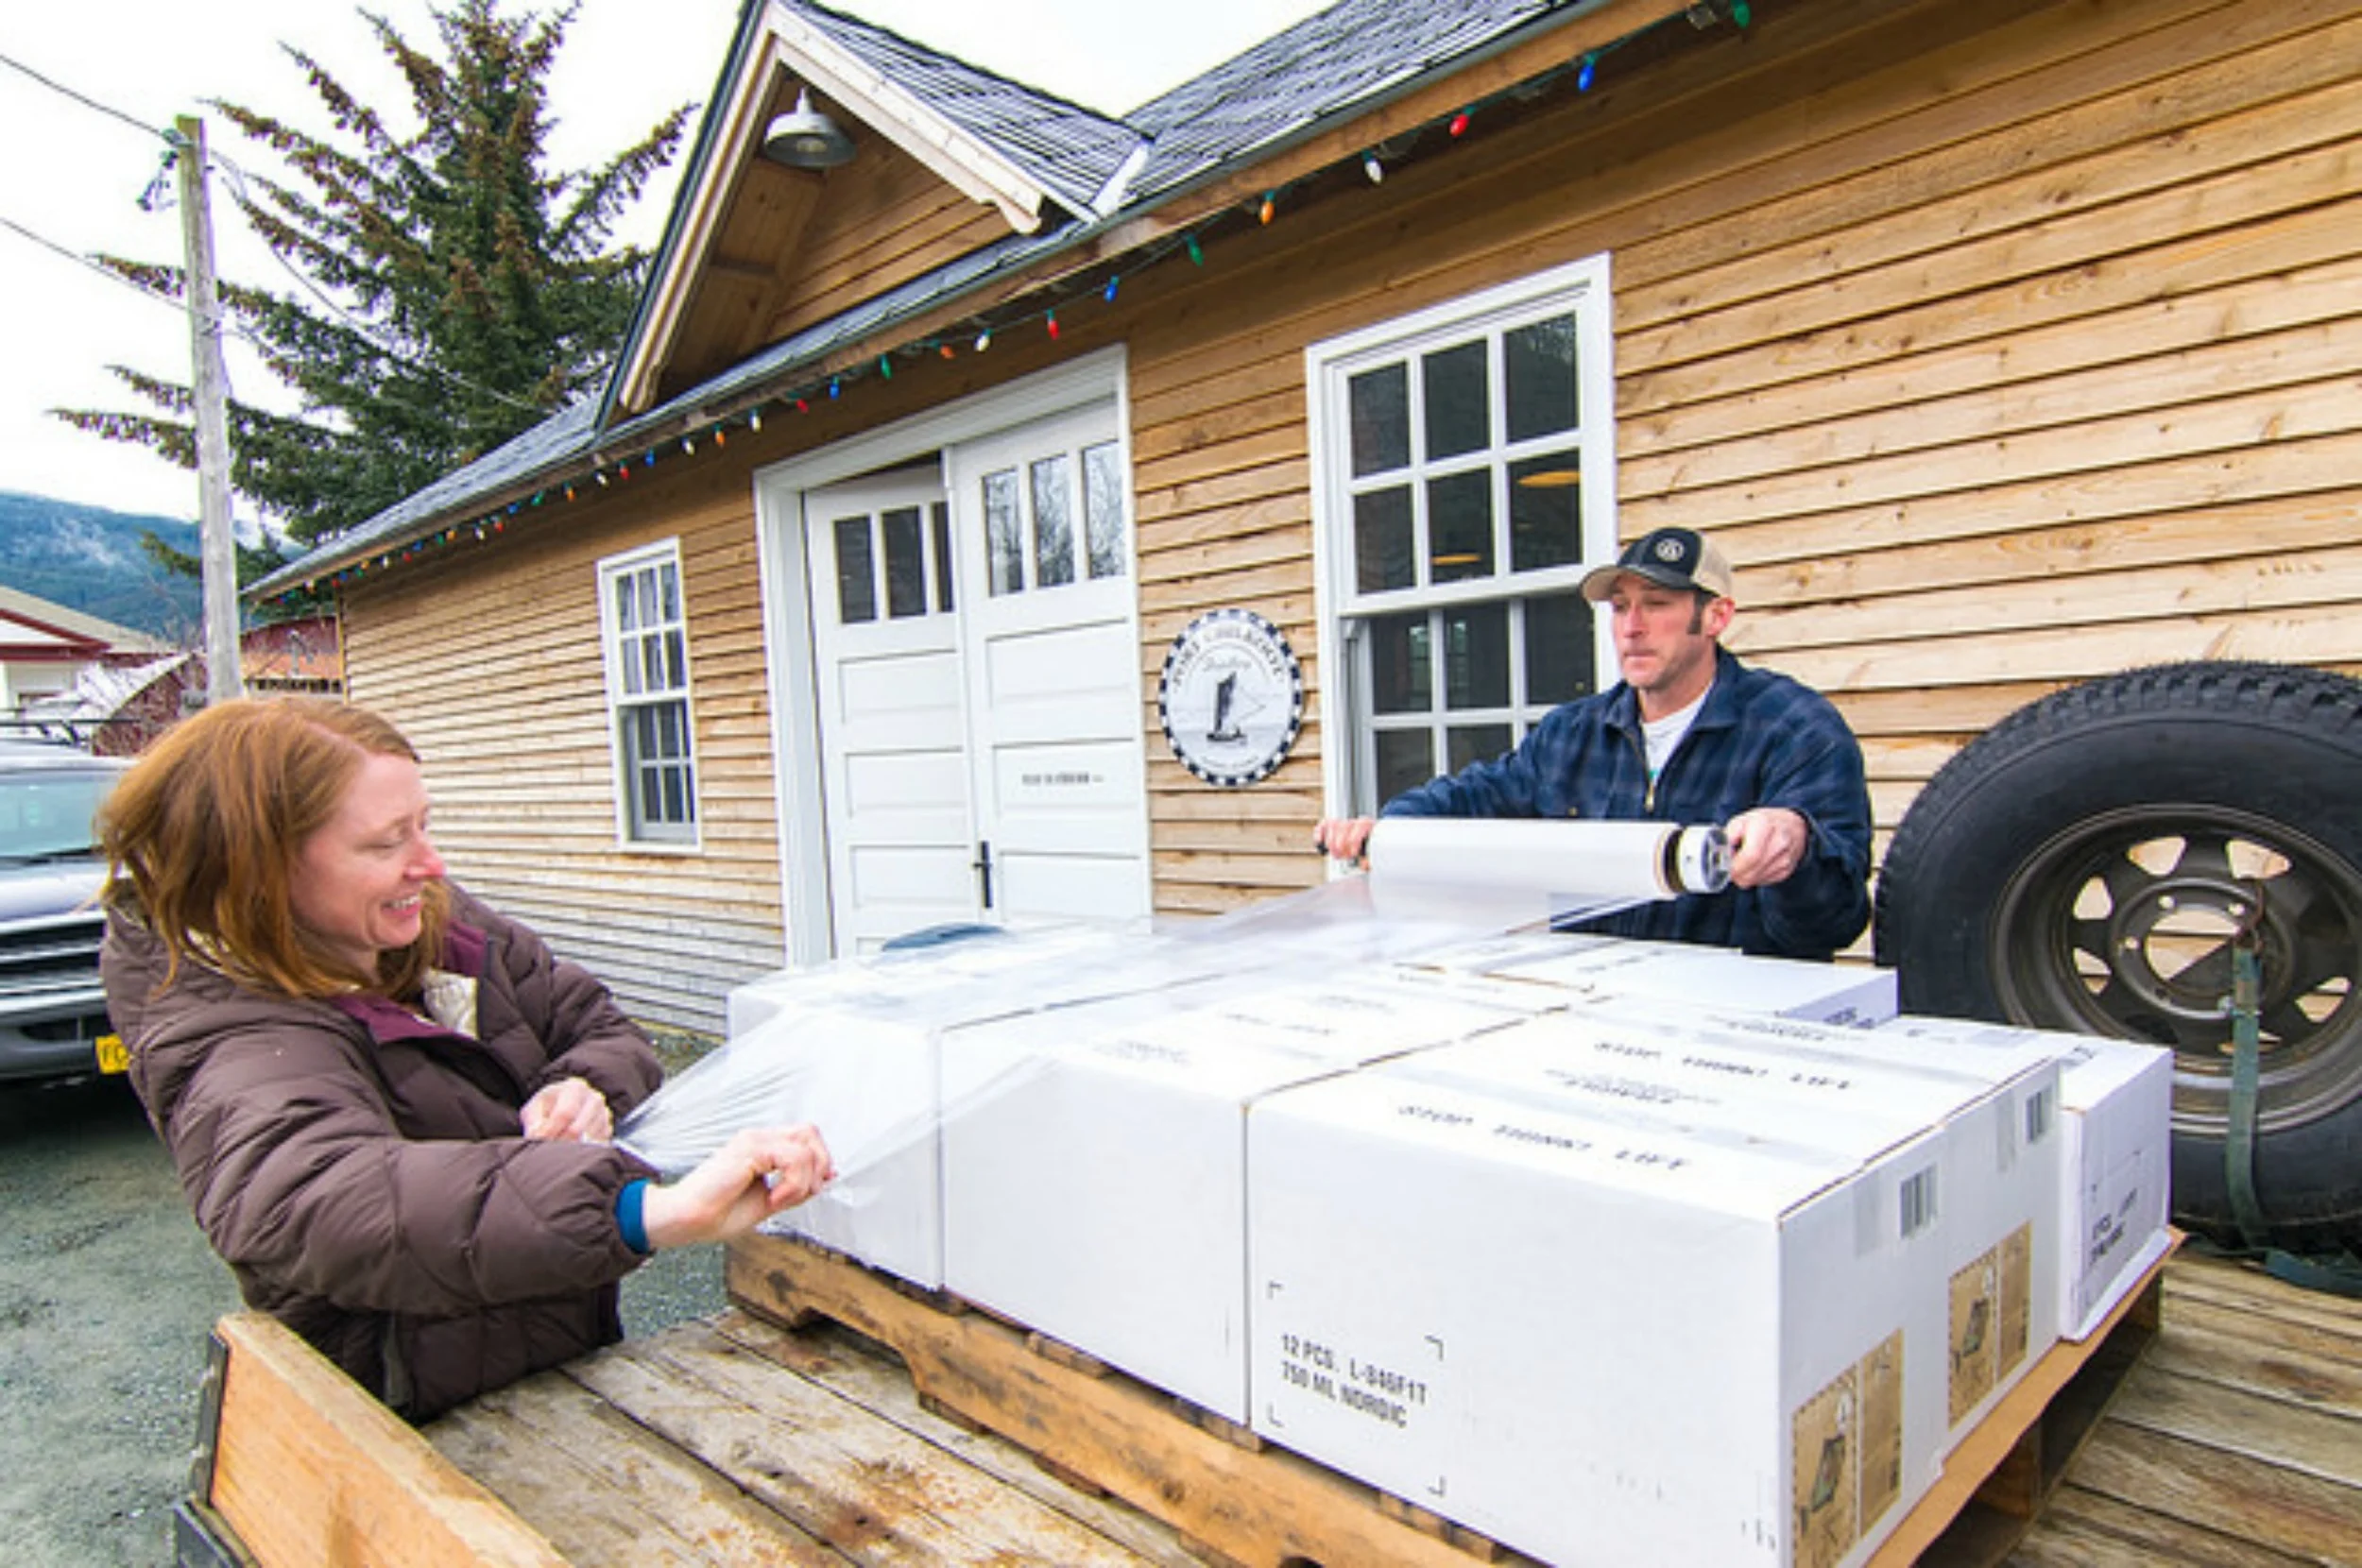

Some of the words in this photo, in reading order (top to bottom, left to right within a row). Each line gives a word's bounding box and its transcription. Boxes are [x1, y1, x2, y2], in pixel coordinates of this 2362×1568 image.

[1281, 1332, 1300, 1357] 12
[1280, 1359, 1309, 1389] 750
[1312, 1371, 1337, 1402] ML
[1339, 1382, 1408, 1429] NORDIC
